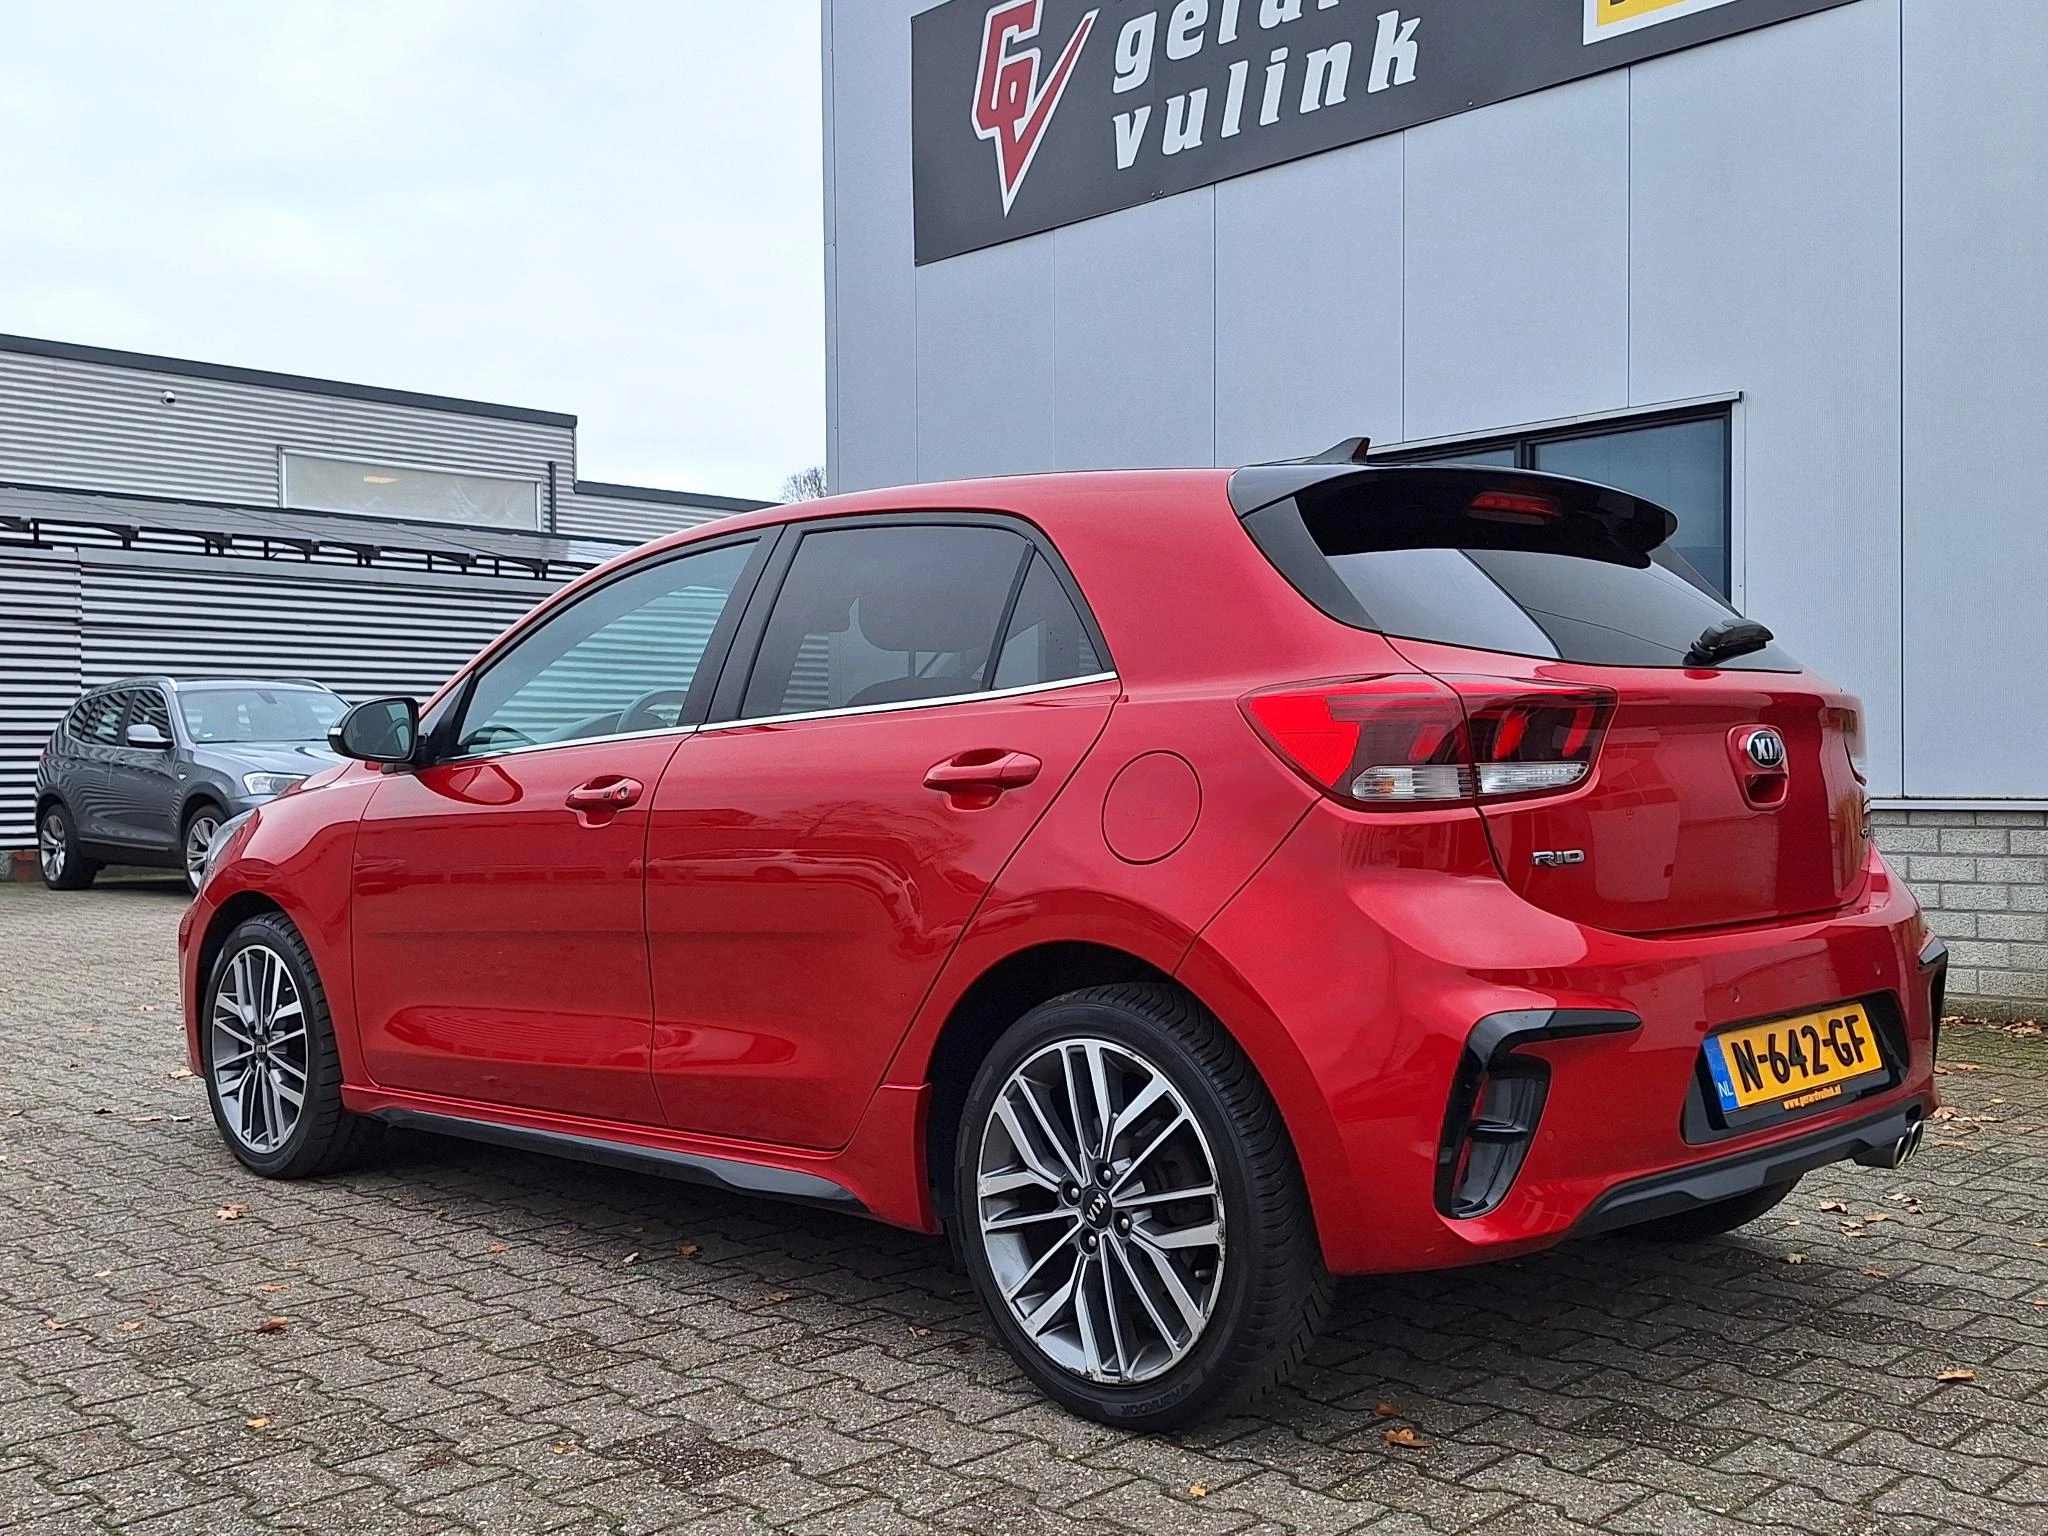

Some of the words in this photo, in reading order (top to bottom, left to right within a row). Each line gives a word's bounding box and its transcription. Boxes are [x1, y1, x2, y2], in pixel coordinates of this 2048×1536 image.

[1112, 10, 1421, 170] vulink
[1753, 737, 1783, 760] KIA
[1532, 849, 1585, 867] RIO
[1731, 1014, 1865, 1093] N-642-GF
[1717, 1080, 1734, 1098] NL
[1086, 1192, 1107, 1222] KIA
